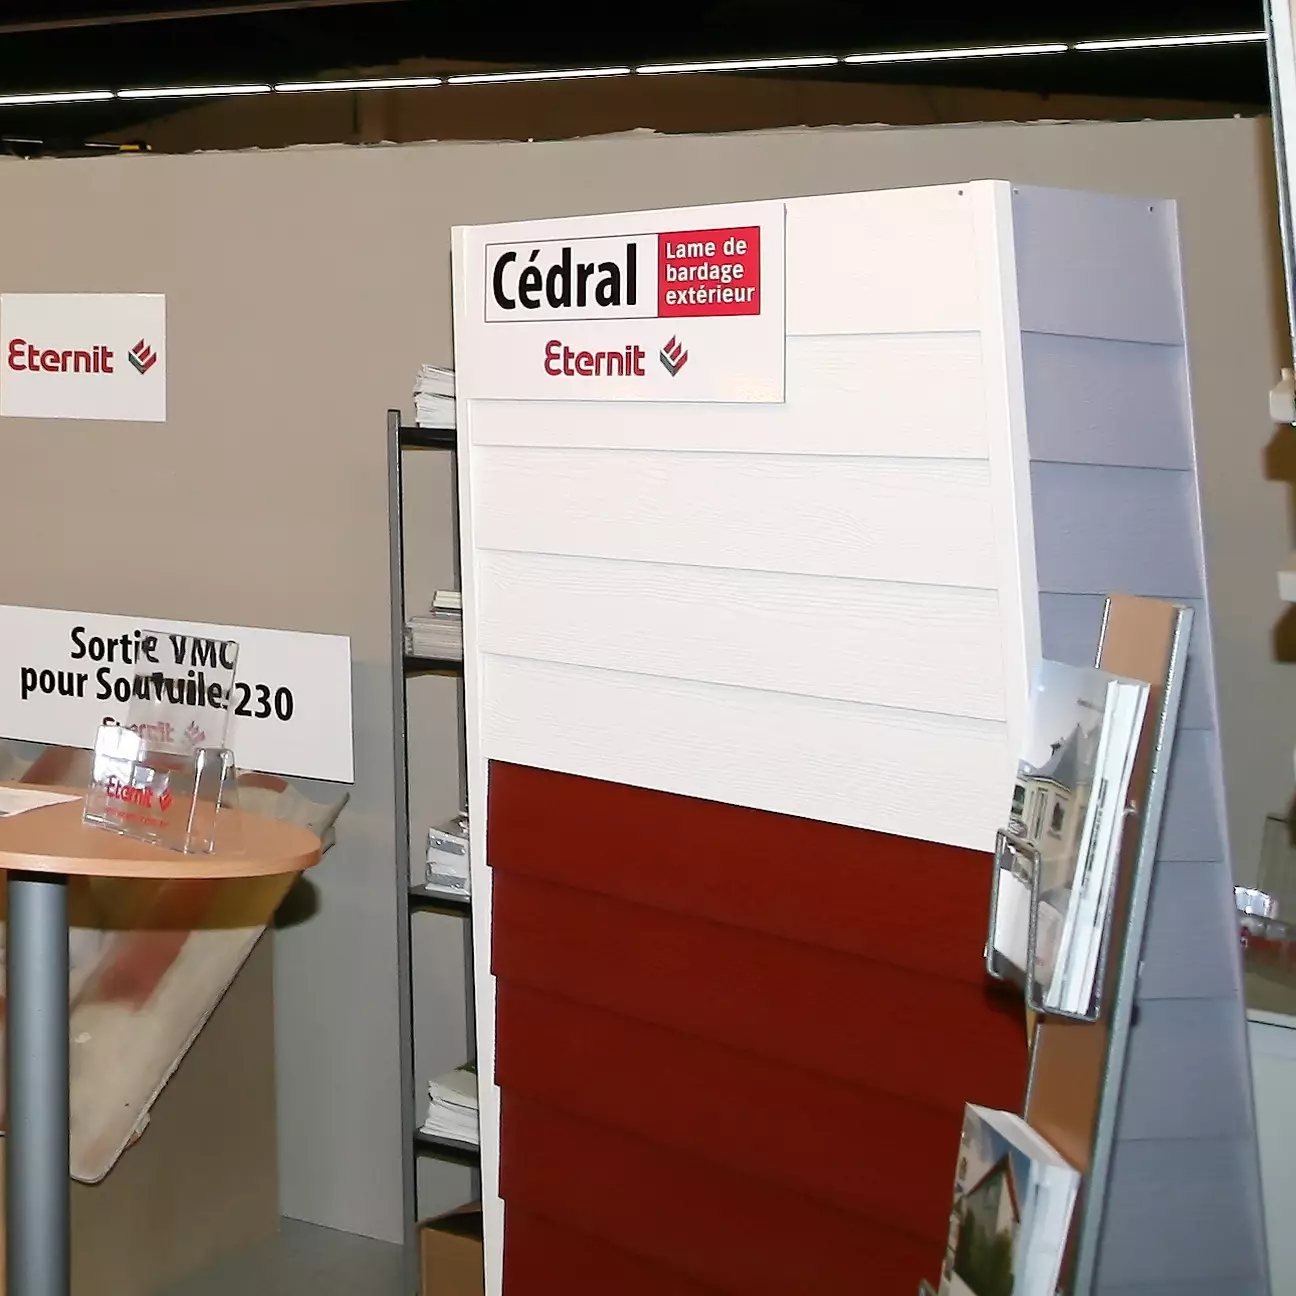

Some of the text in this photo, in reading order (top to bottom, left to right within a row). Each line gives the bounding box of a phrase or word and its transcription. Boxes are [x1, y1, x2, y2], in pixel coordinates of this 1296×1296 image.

[665, 237, 748, 260] Lame de
[493, 243, 637, 310] Cédral
[666, 261, 744, 284] bardage
[665, 284, 756, 306] extérieur
[7, 338, 114, 375] Eternit
[544, 339, 646, 377] Eternit
[70, 626, 237, 670] Sortie VMC
[20, 666, 88, 700] pour
[234, 682, 294, 722] 230
